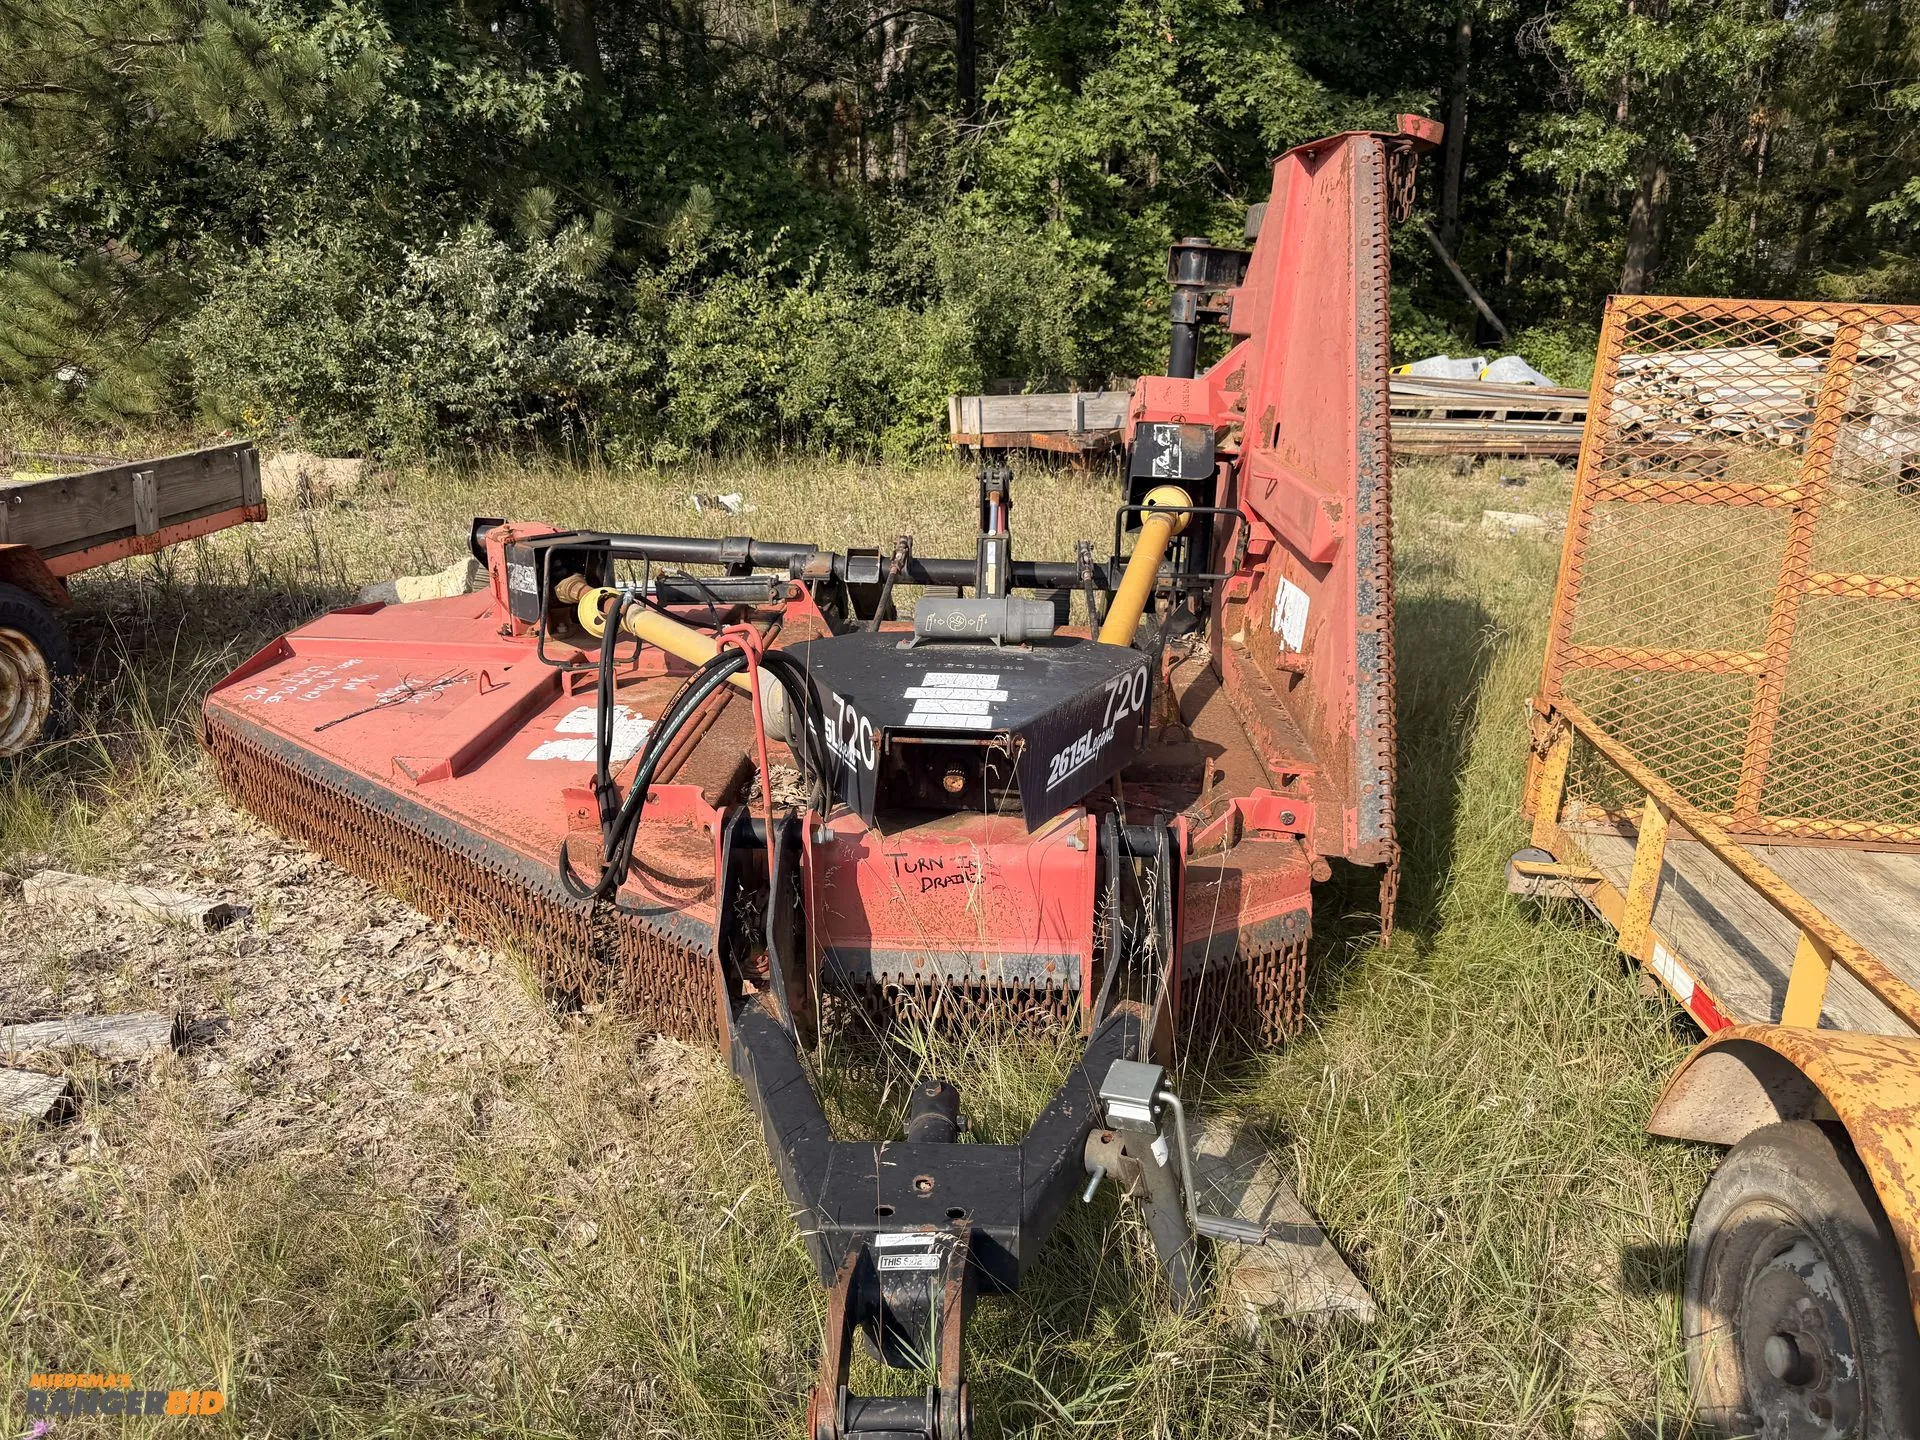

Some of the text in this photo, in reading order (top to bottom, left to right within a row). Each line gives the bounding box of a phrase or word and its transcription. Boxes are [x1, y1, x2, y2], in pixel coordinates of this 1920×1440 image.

[1102, 665, 1148, 729] 720
[832, 691, 875, 771] 720
[883, 852, 944, 878] TURN
[883, 1257, 902, 1267] THIS
